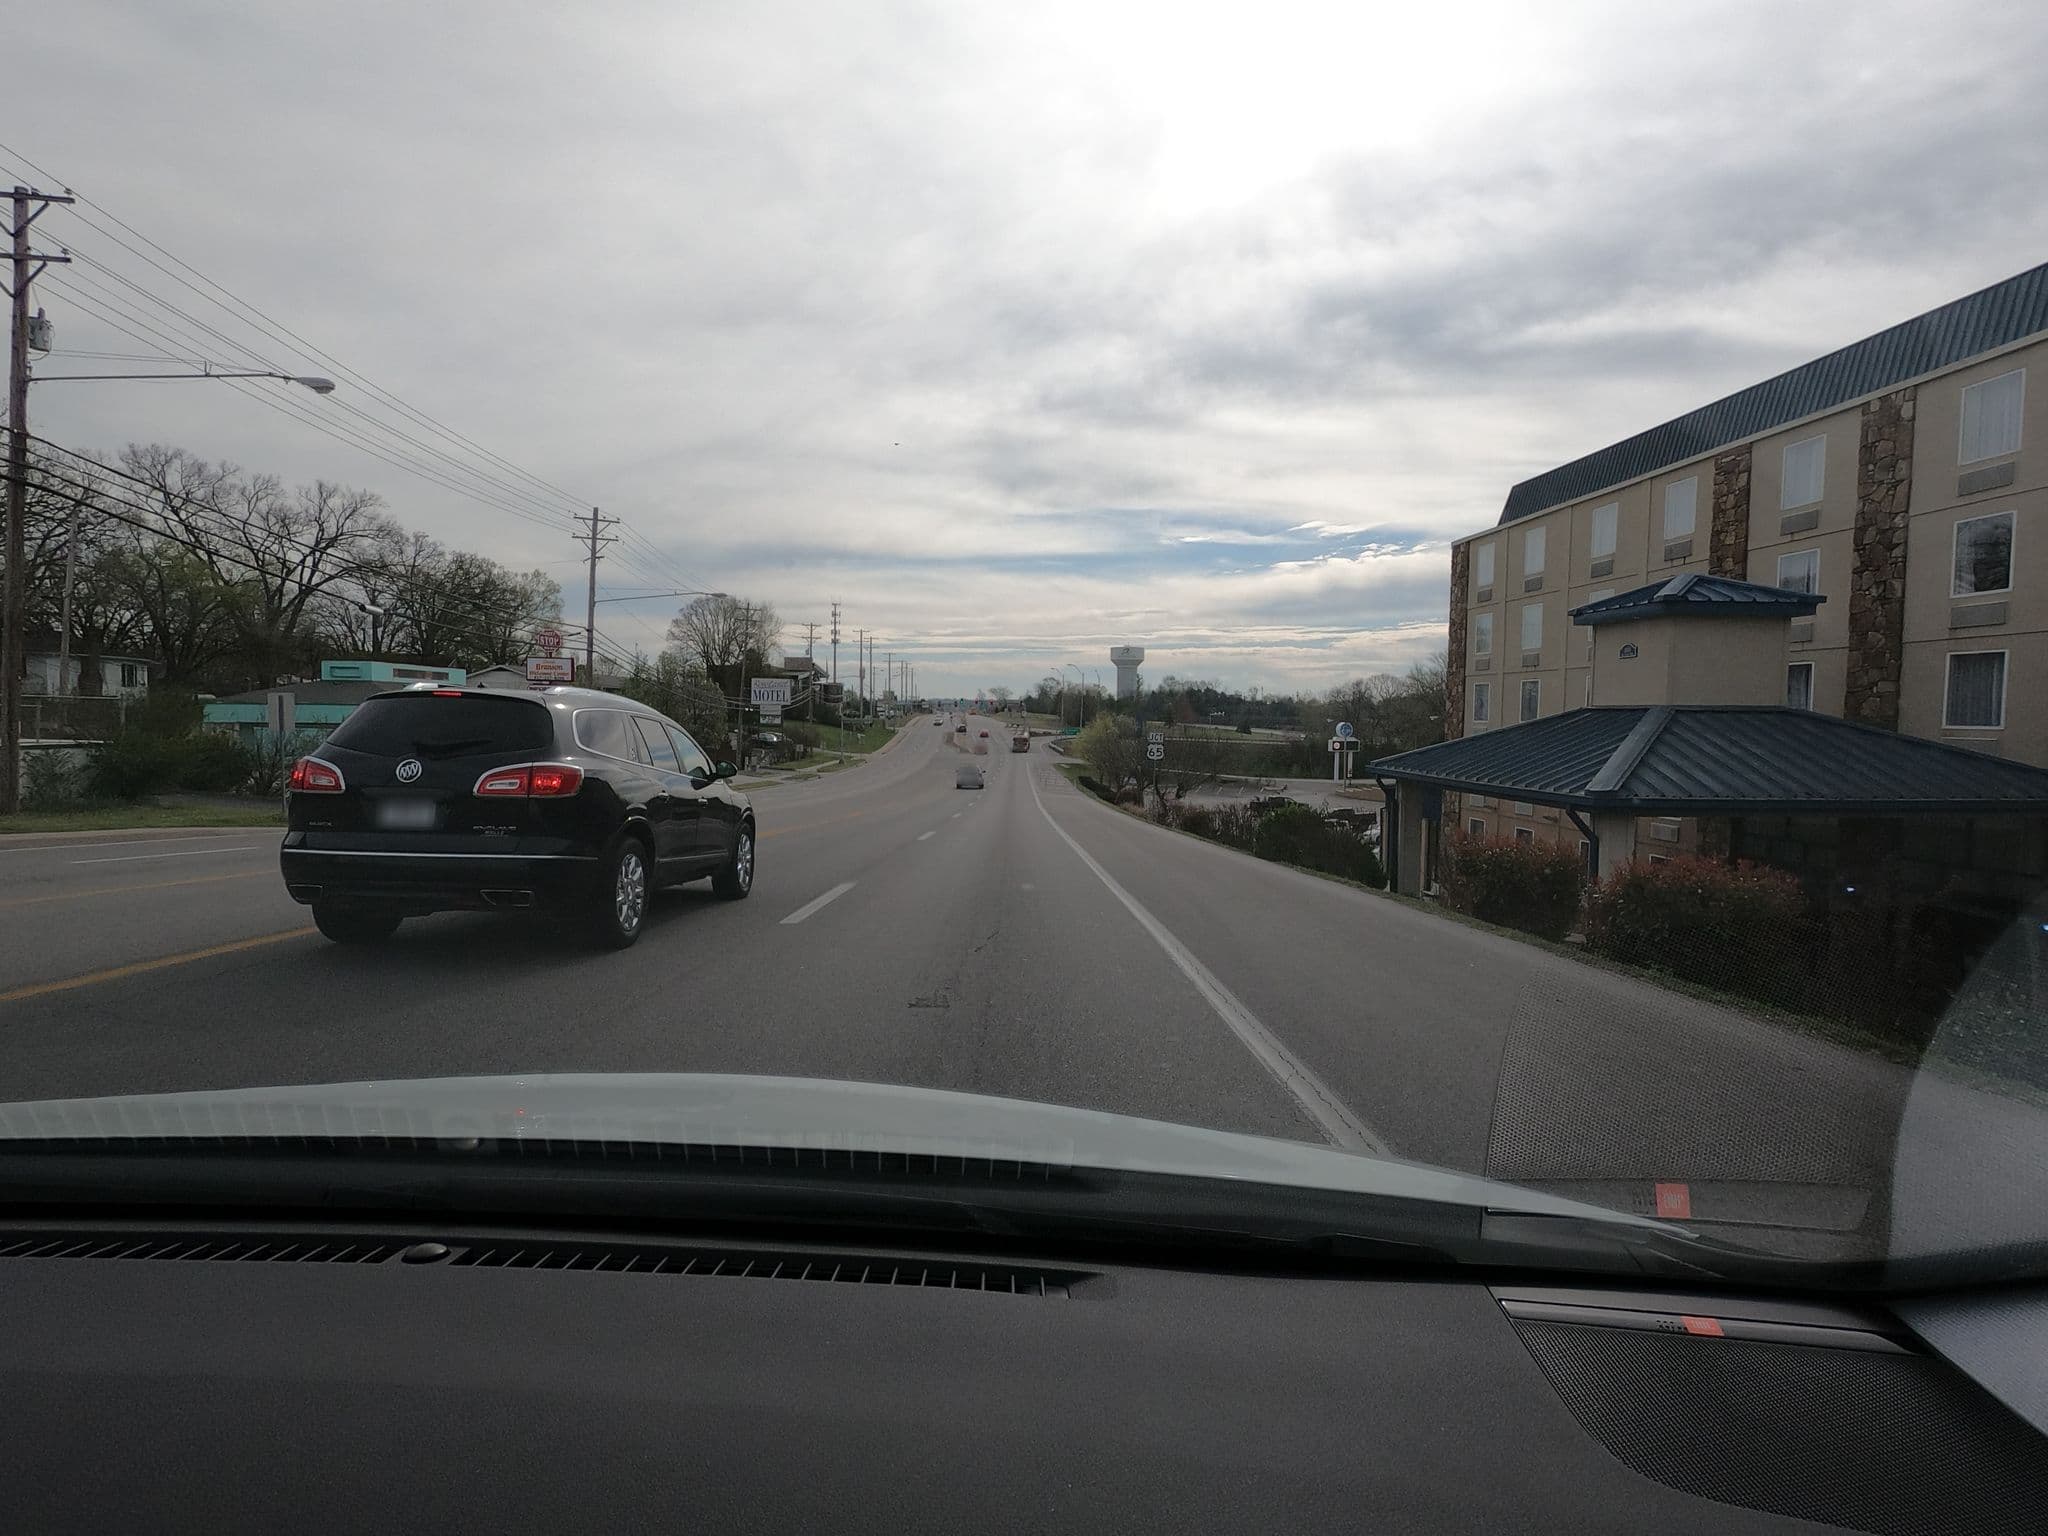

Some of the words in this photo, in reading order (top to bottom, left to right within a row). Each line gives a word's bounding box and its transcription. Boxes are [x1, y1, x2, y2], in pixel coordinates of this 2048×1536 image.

[539, 636, 560, 646] STOP
[753, 689, 789, 702] MOTEL
[1149, 733, 1163, 742] JCT
[1149, 748, 1163, 757] 65
